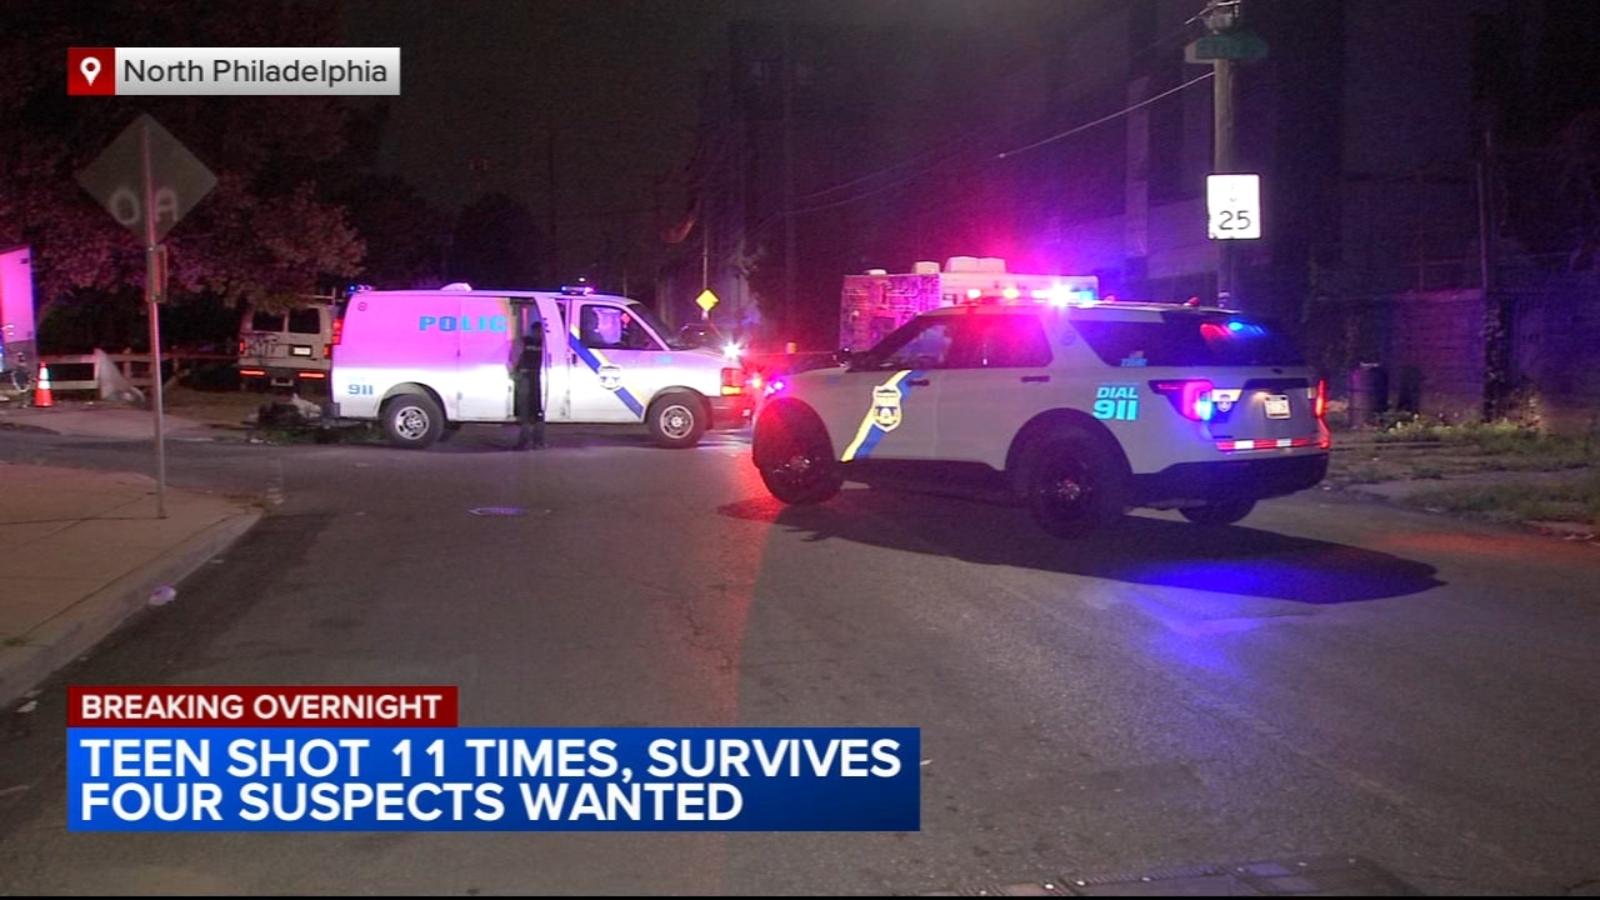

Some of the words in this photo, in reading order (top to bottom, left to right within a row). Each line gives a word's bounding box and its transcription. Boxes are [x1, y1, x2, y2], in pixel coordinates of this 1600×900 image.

[1218, 210, 1251, 231] 25
[348, 384, 374, 396] 911
[1096, 386, 1140, 399] DIAL
[1093, 399, 1138, 421] 911
